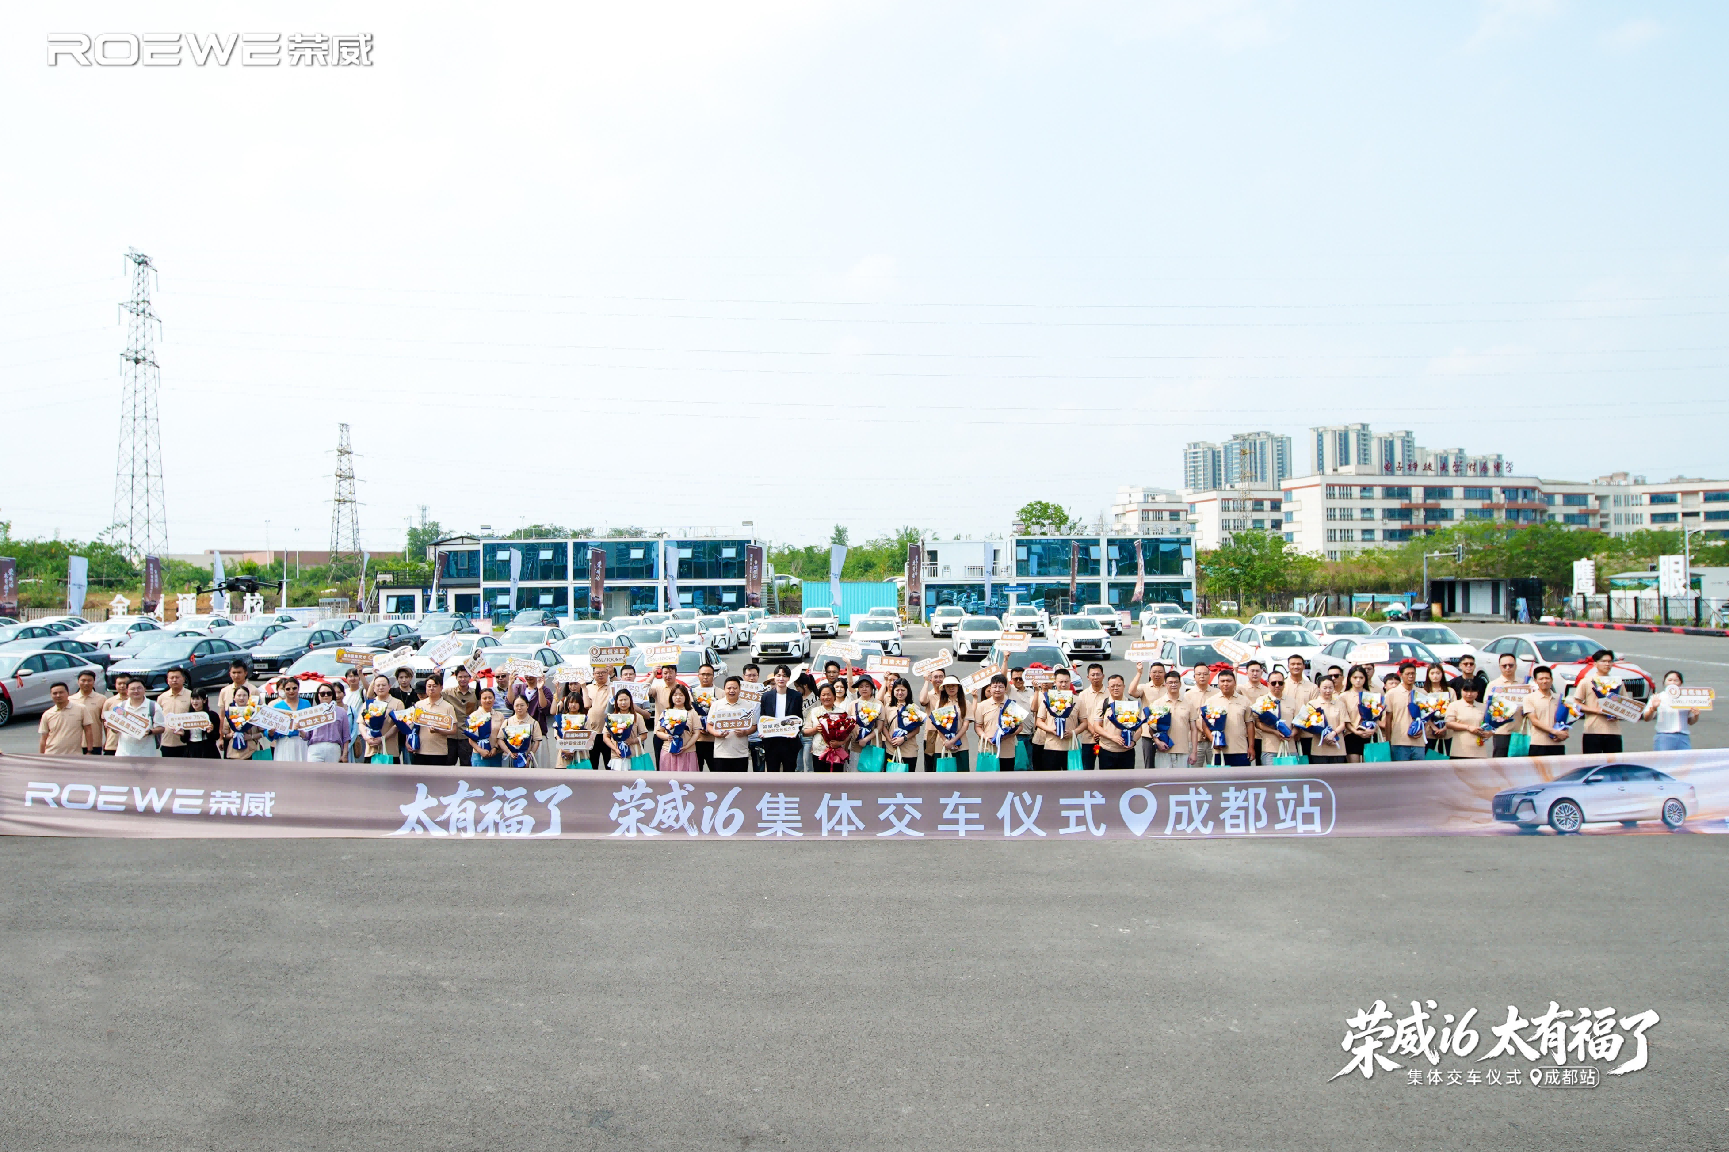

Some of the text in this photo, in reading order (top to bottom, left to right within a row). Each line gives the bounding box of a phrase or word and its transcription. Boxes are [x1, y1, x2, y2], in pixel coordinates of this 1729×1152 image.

[24, 778, 1323, 838] ROEWE 荣威 太有福了 荣威i6 集体交车仪式 成都站
